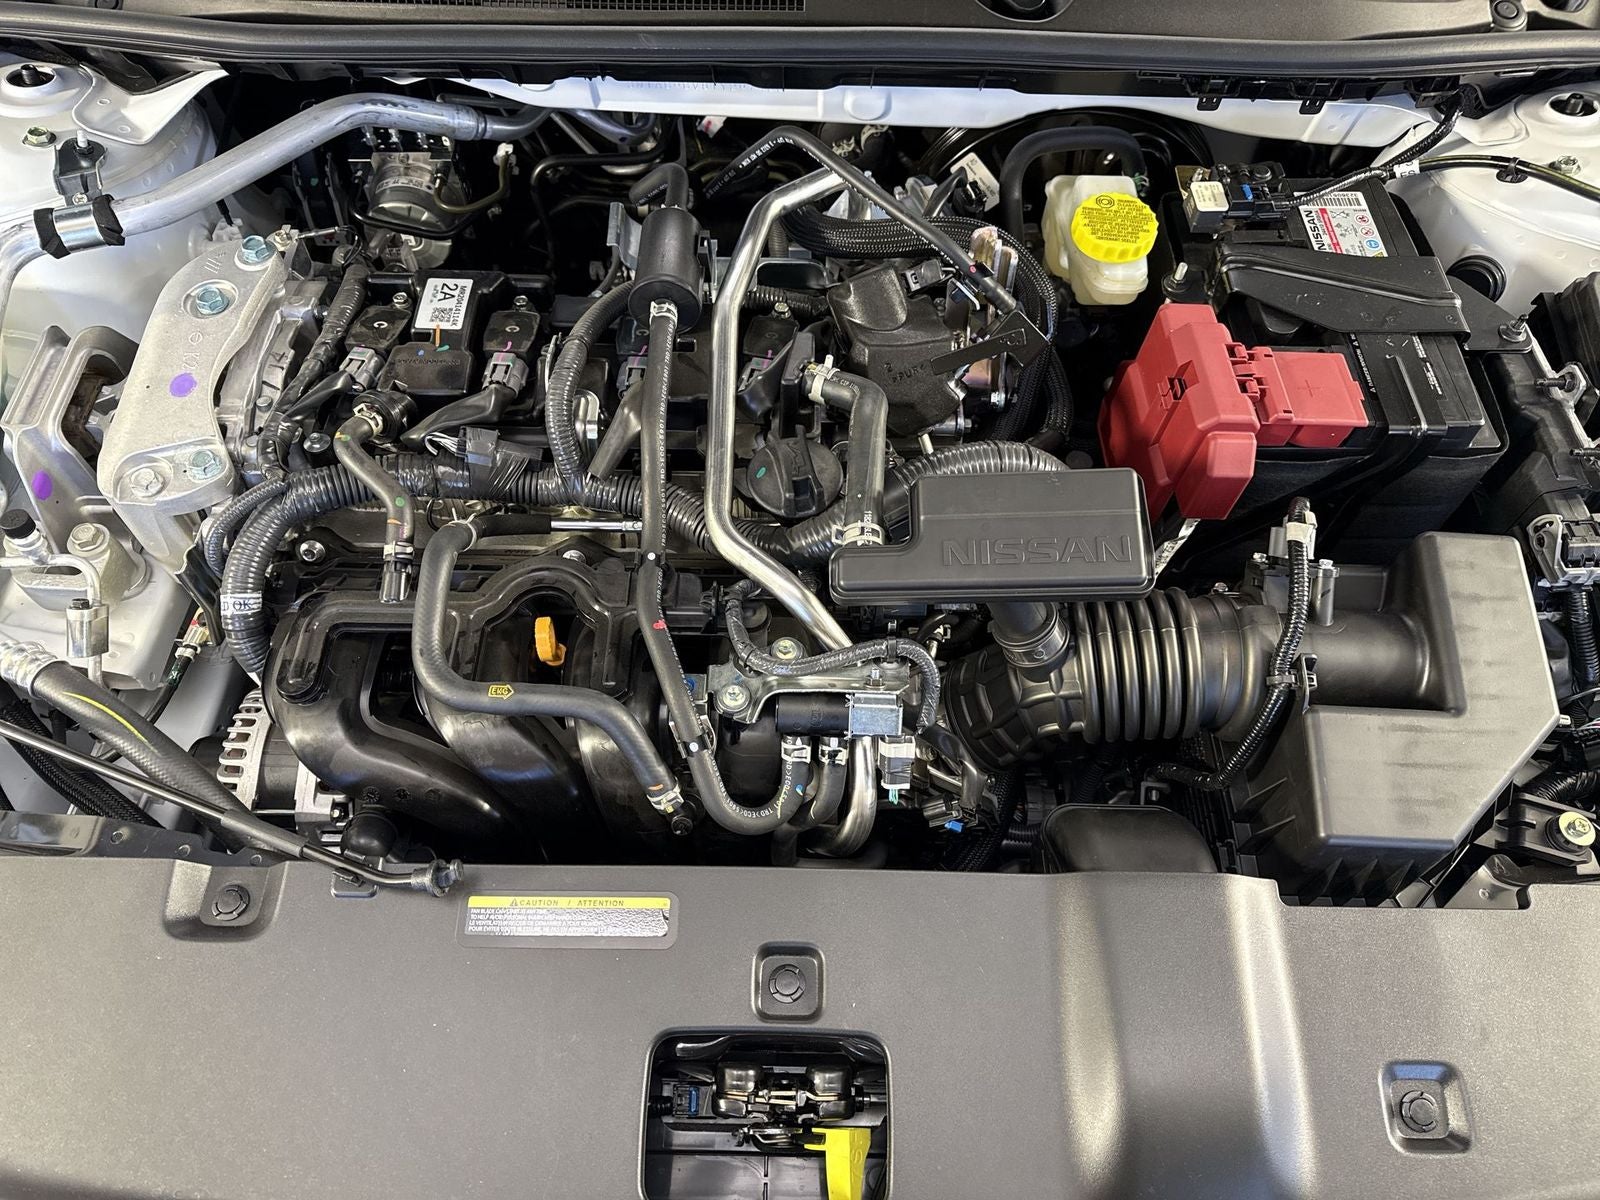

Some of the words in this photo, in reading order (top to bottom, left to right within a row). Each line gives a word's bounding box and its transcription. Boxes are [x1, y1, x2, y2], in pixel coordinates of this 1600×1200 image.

[1303, 210, 1327, 251] NISSAN
[437, 283, 459, 302] 2A
[942, 534, 1133, 567] NISSAN
[519, 899, 559, 907] CAUTION
[577, 899, 625, 907] ATTENTION
